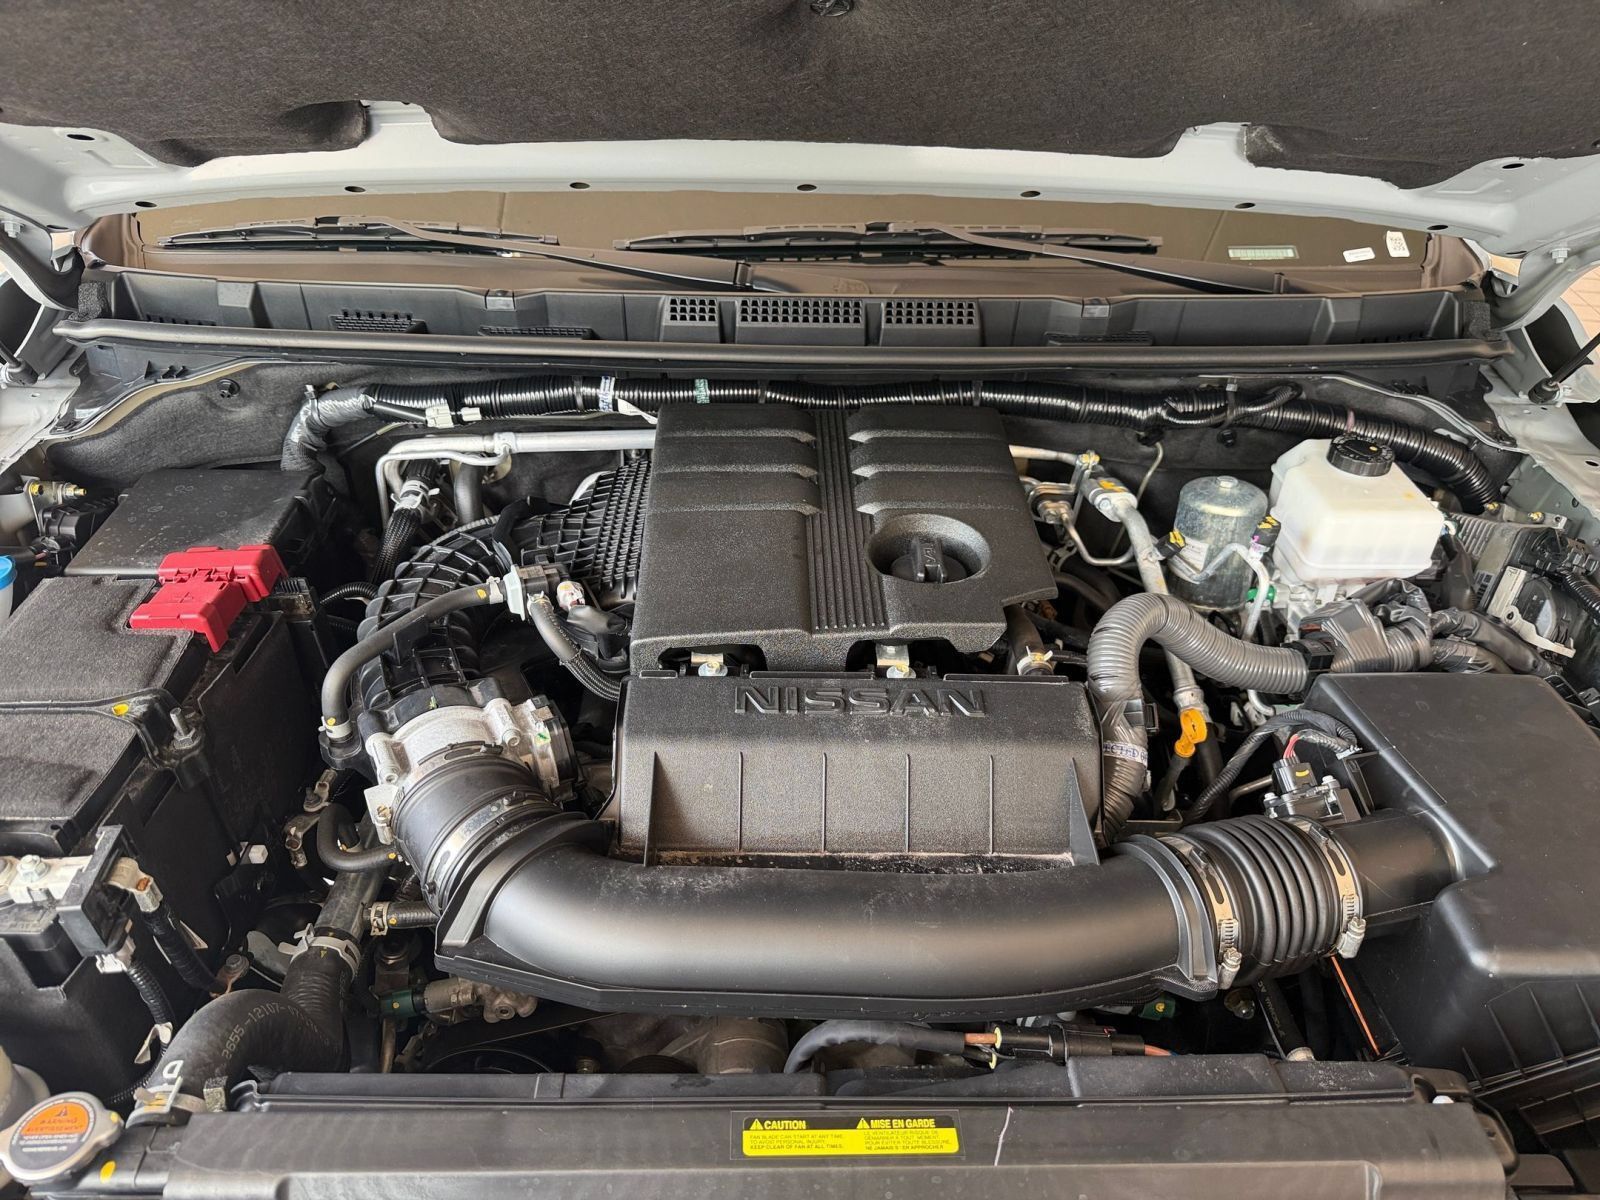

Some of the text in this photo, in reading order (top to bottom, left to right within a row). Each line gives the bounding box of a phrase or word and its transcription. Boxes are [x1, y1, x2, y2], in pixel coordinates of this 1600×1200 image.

[734, 686, 986, 718] NISSAN
[763, 1120, 807, 1130] CAUTION
[870, 1118, 936, 1129] MISE EN GARDE
